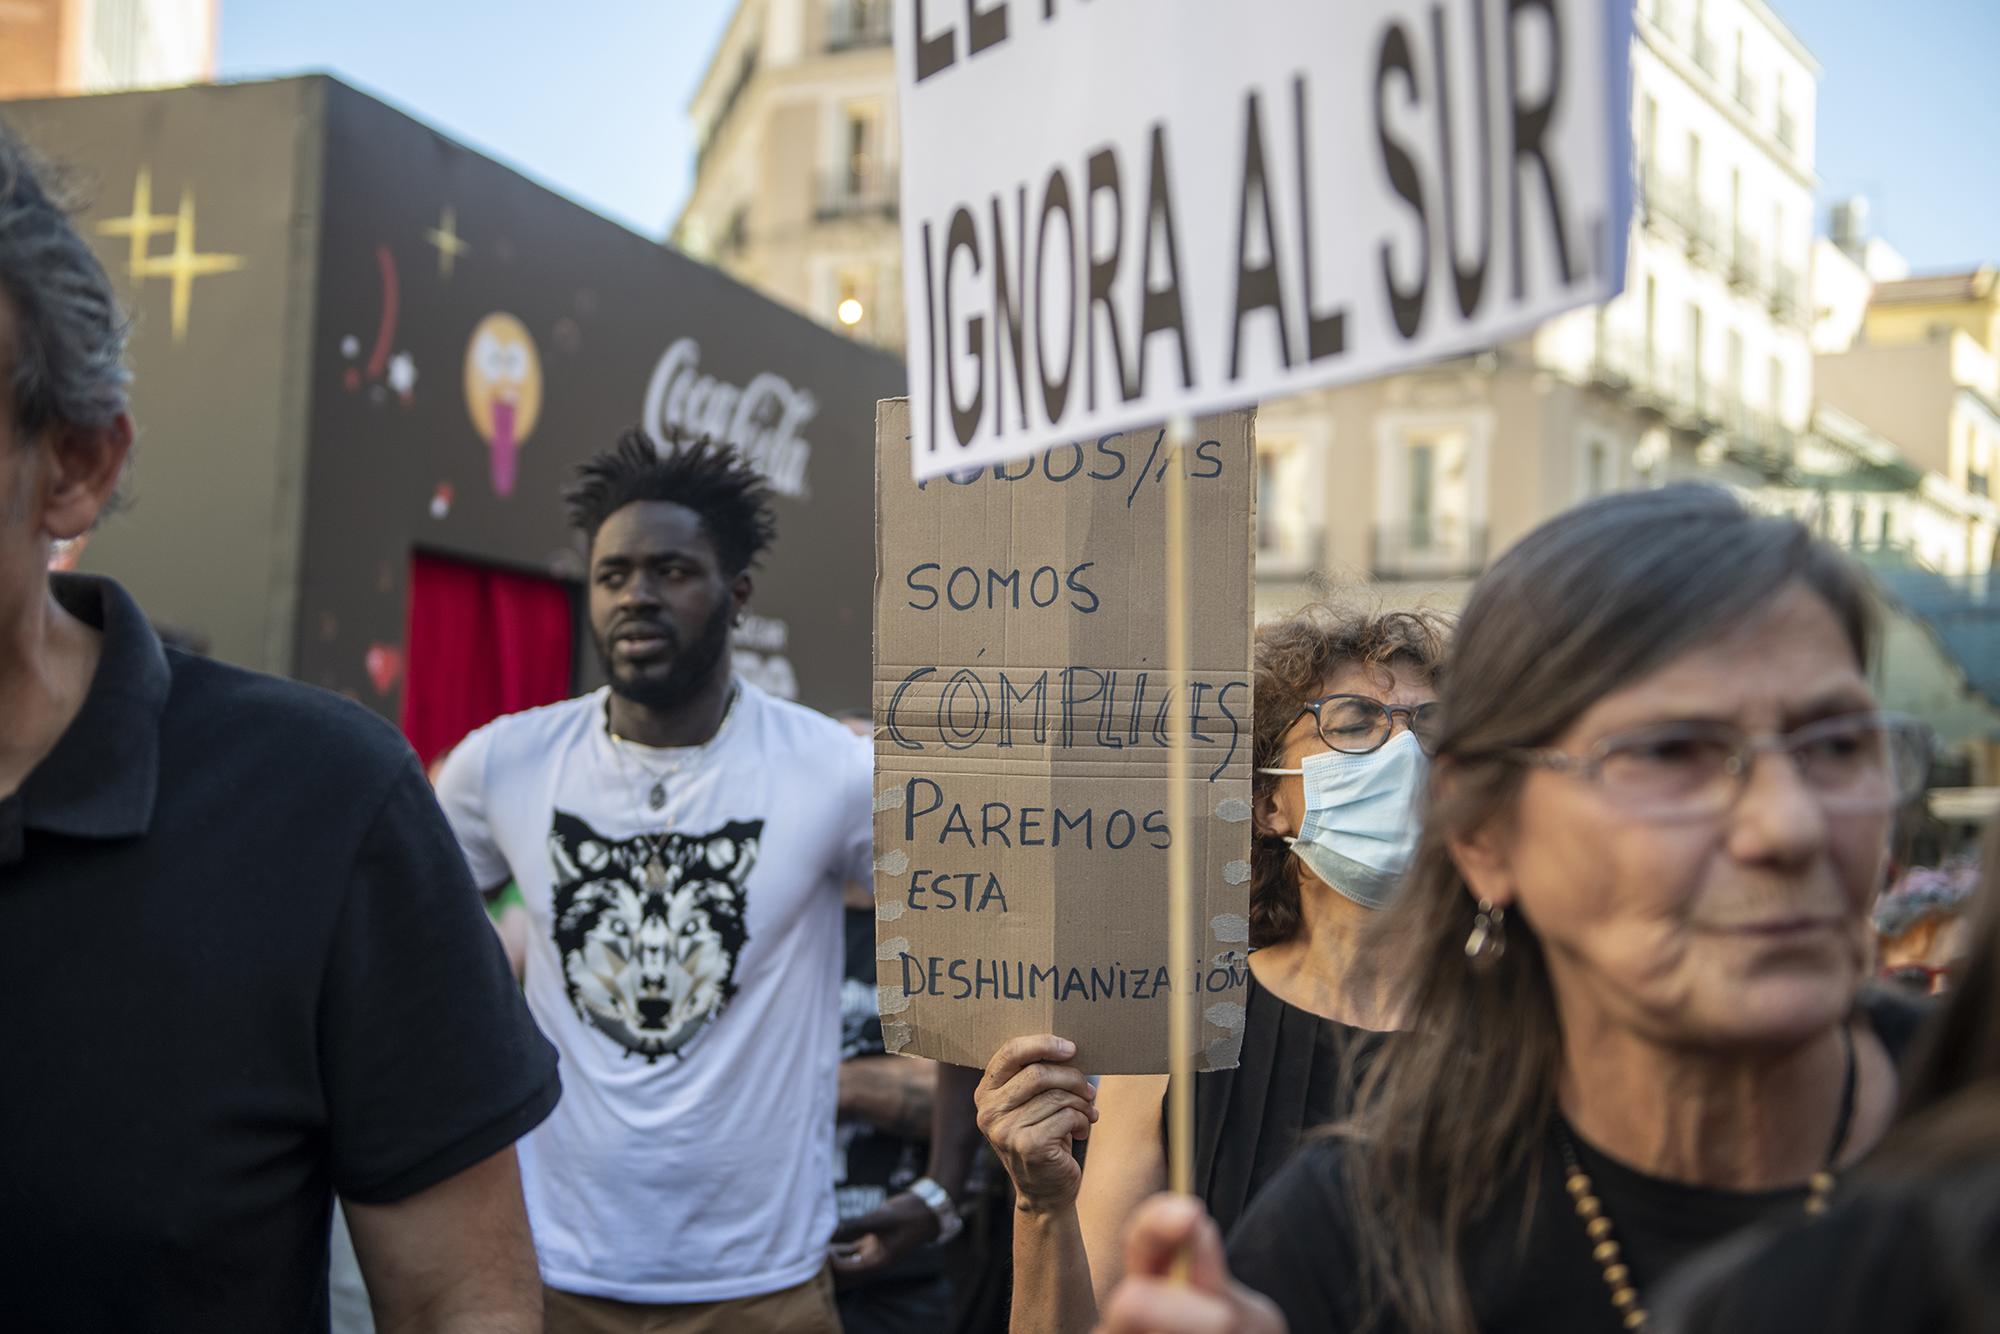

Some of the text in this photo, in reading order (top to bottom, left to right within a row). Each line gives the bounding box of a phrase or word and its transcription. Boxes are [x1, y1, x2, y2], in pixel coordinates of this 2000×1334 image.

[922, 122, 1198, 454] IGNORA
[1228, 75, 1348, 384] AL
[906, 562, 1099, 614] SOMOS
[907, 869, 1008, 912] ESTA
